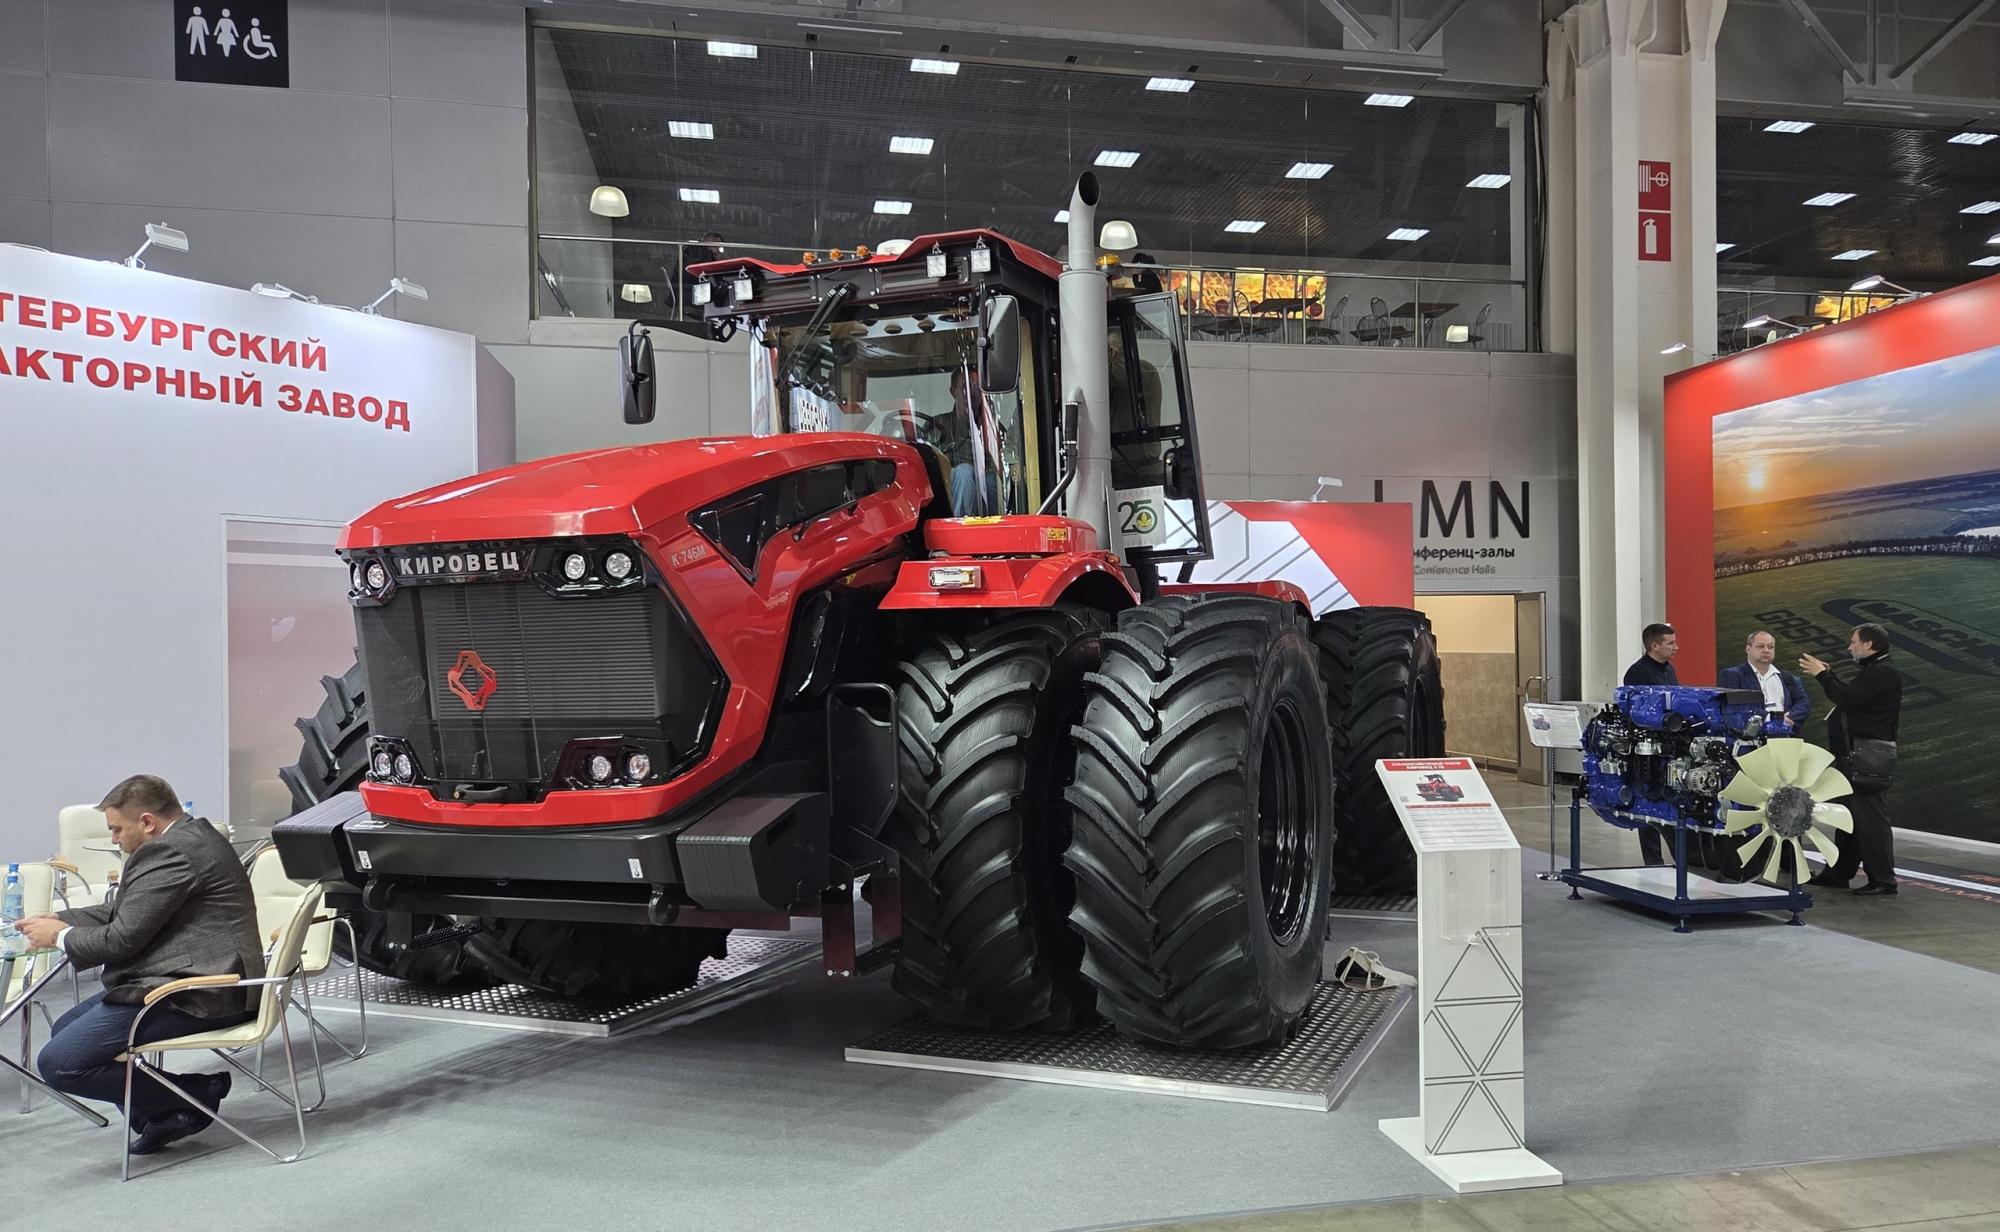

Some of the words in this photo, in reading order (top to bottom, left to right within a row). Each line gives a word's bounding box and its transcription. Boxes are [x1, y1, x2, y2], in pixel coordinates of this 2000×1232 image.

[278, 384, 411, 432] ЗАВОД
[1117, 499, 1158, 534] 25
[400, 551, 520, 576] КИРОВЕЦ
[1472, 564, 1497, 575] Halls
